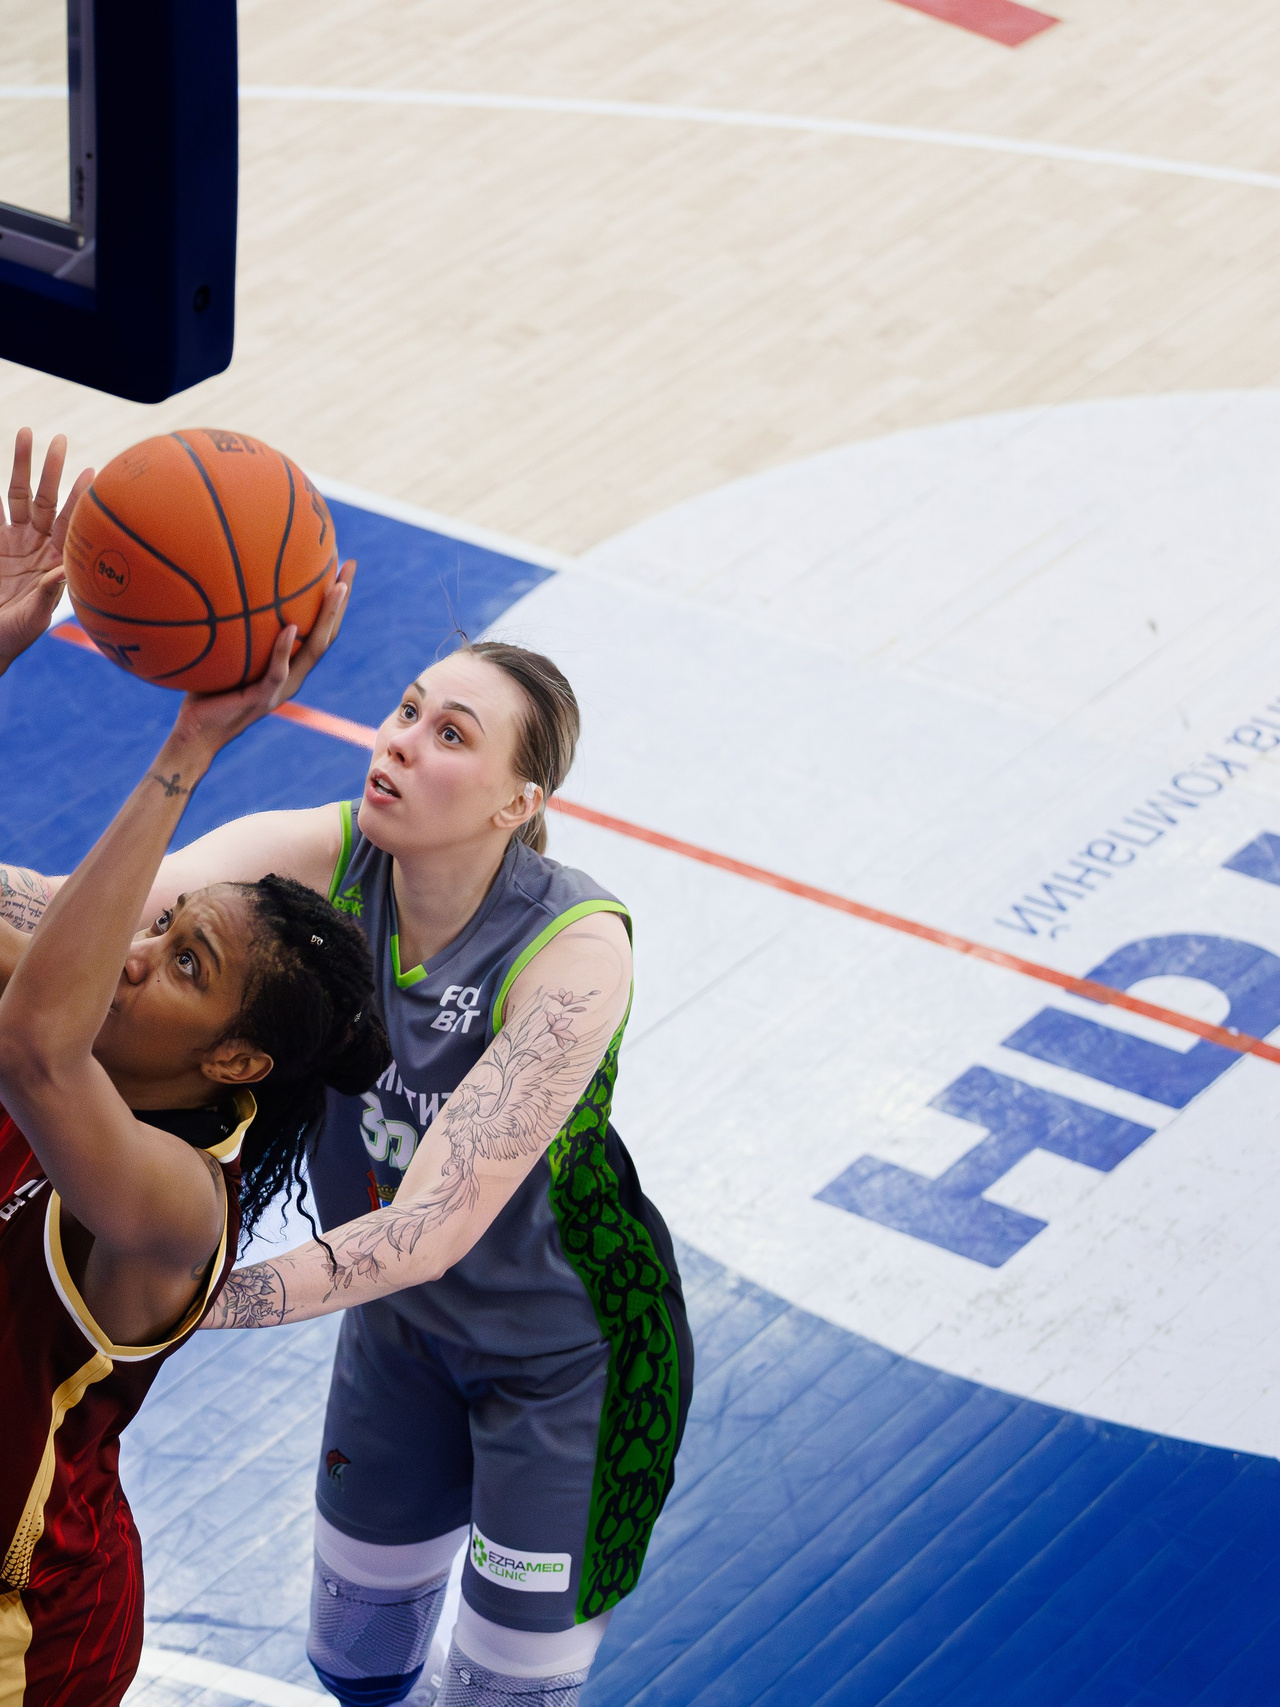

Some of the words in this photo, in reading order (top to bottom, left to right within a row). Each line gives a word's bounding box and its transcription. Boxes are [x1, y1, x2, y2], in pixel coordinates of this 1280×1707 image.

[994, 752, 1247, 940] компаний
[439, 985, 482, 1010] FO
[430, 1010, 481, 1034] BT
[487, 1563, 527, 1583] CLINIC
[488, 1550, 564, 1574] EZRAMED
